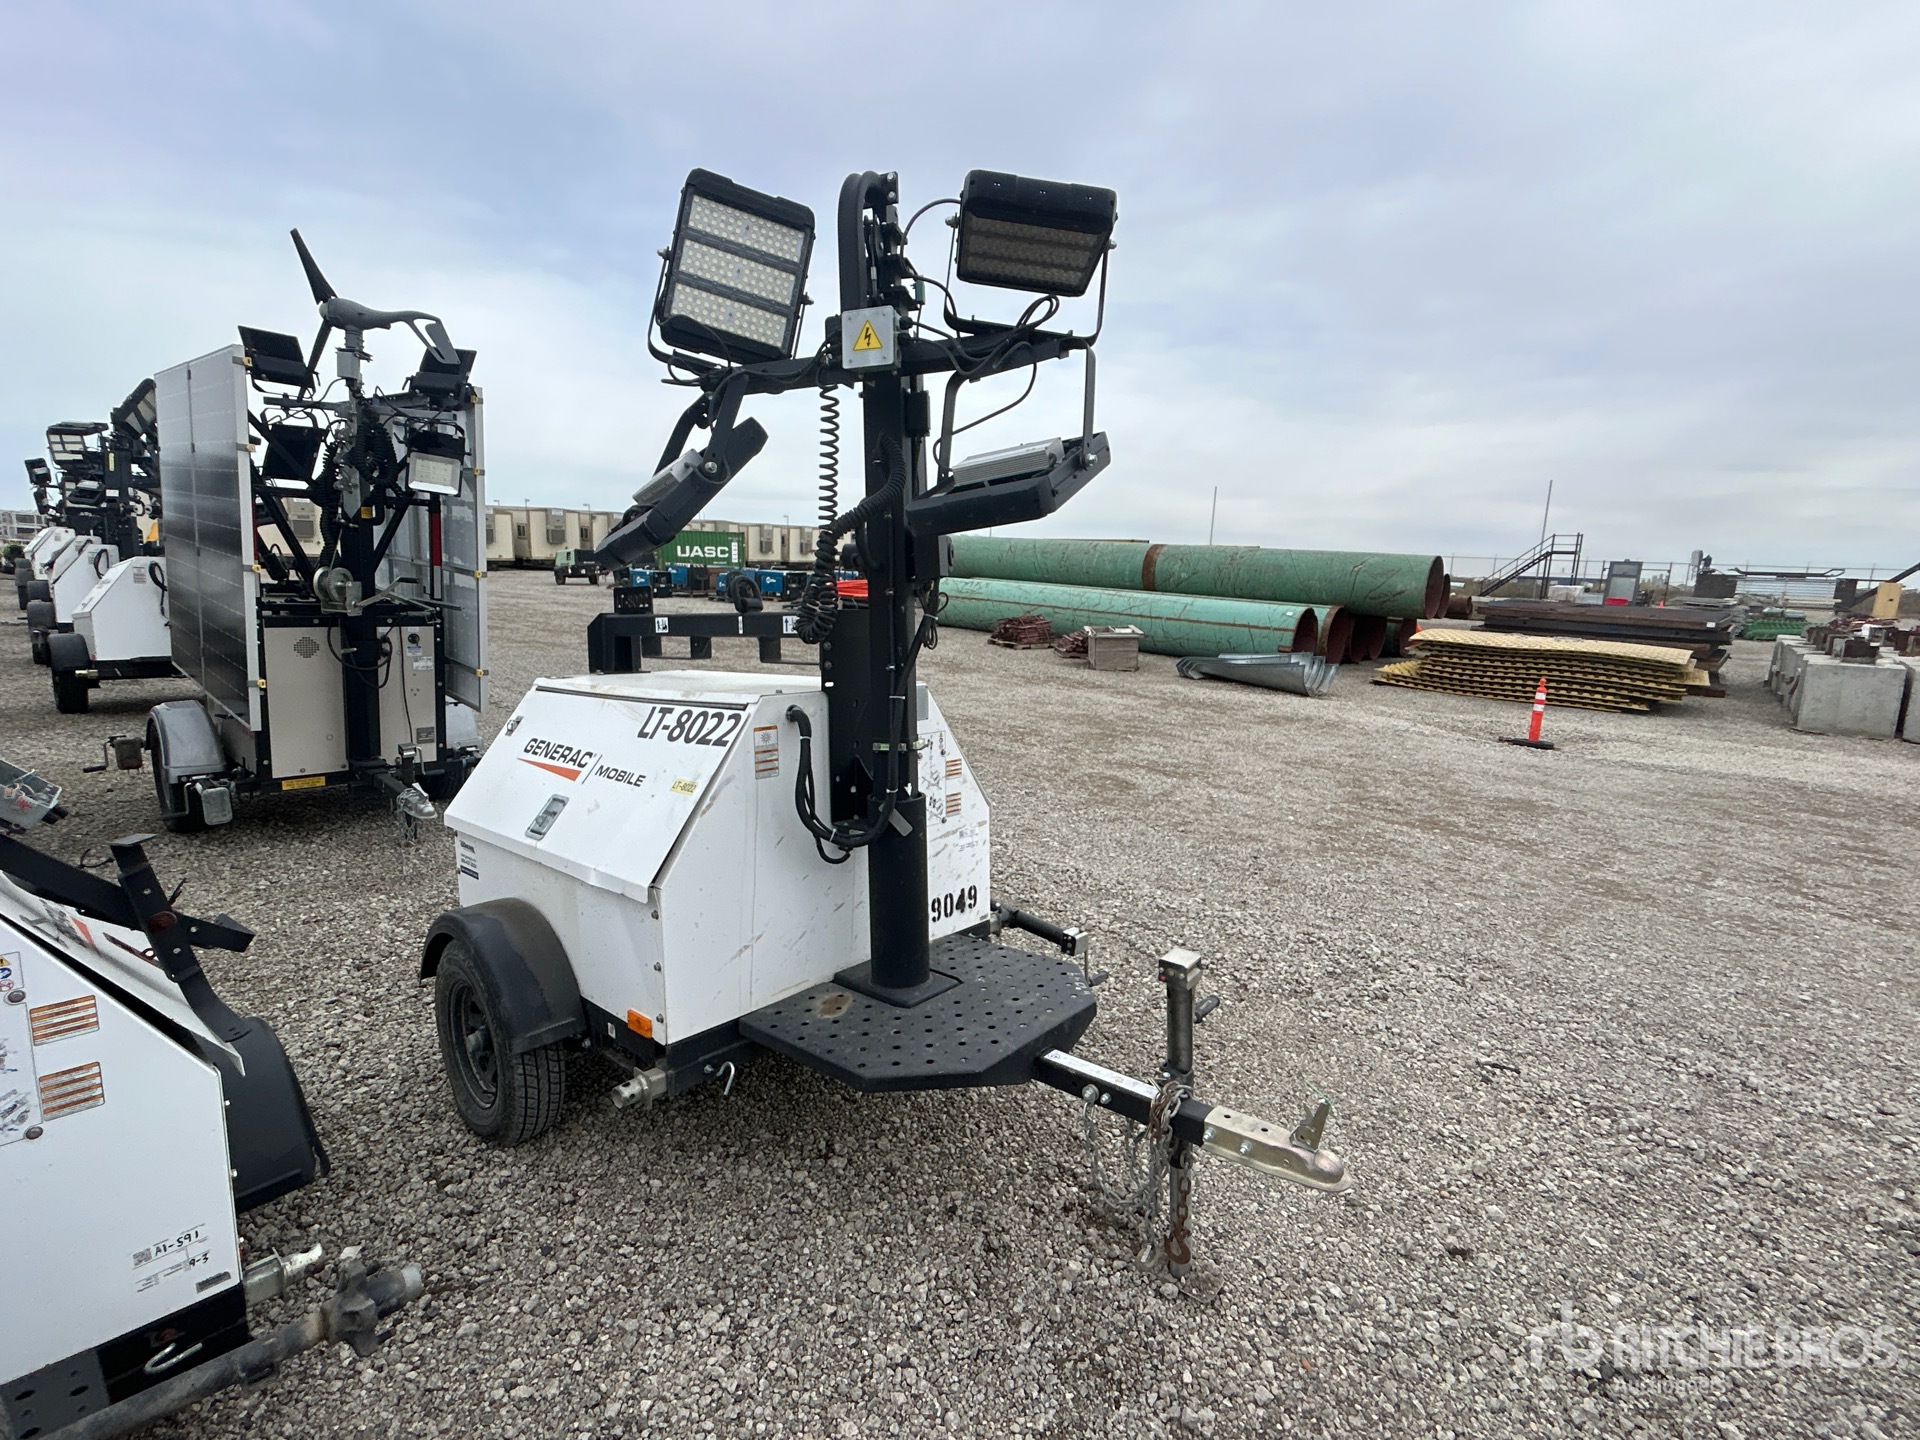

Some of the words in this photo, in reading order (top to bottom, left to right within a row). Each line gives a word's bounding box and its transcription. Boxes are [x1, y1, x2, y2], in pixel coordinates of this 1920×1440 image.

[677, 545, 729, 558] UASC
[637, 706, 742, 747] LT-8022
[523, 738, 594, 769] GENERAC
[595, 764, 647, 787] MOBILE
[672, 781, 697, 793] LT-8022
[931, 885, 977, 922] 9049
